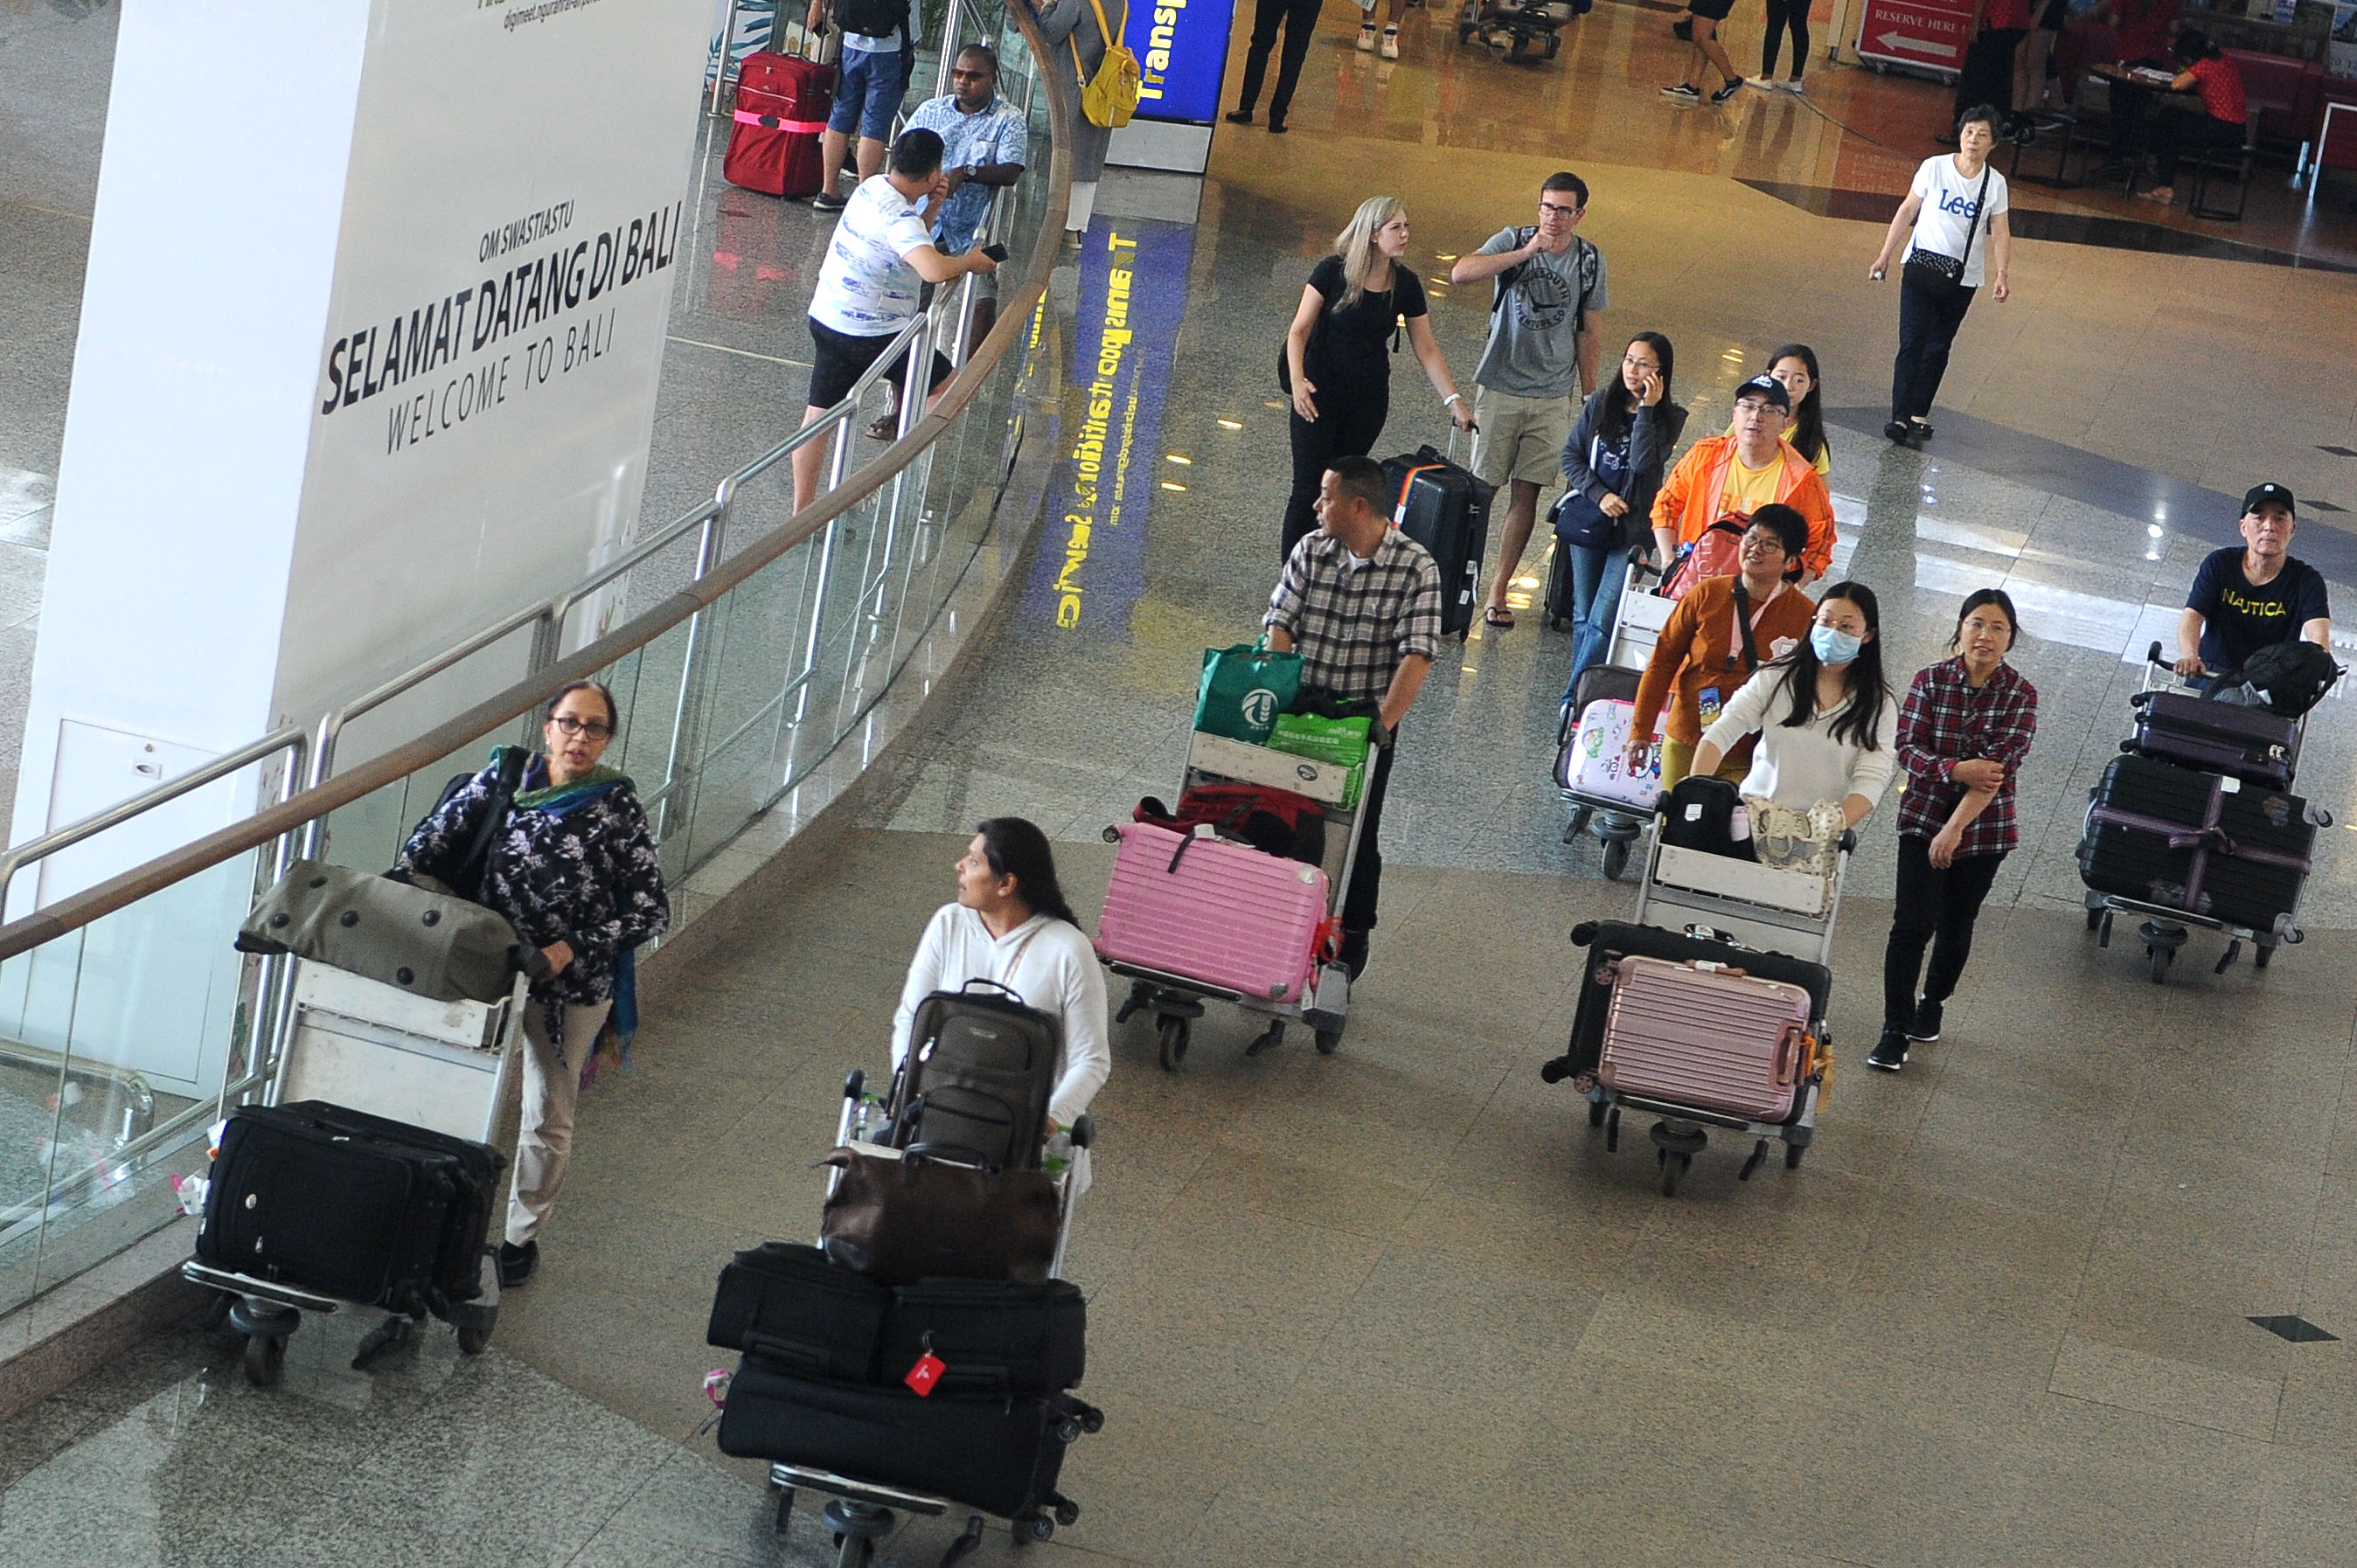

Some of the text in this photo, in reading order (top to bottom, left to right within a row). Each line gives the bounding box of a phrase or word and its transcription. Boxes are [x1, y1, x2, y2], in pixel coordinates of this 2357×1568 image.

[1874, 9, 1923, 27] RESERVE
[1928, 18, 1958, 33] HERE
[1939, 189, 1977, 219] Lee
[479, 199, 574, 263] OM SWASTIASTU
[322, 200, 682, 415] SELAMAT DATANG DI BALI
[387, 308, 615, 454] WELCOME TO BALI
[2221, 587, 2286, 616] NAUTICA
